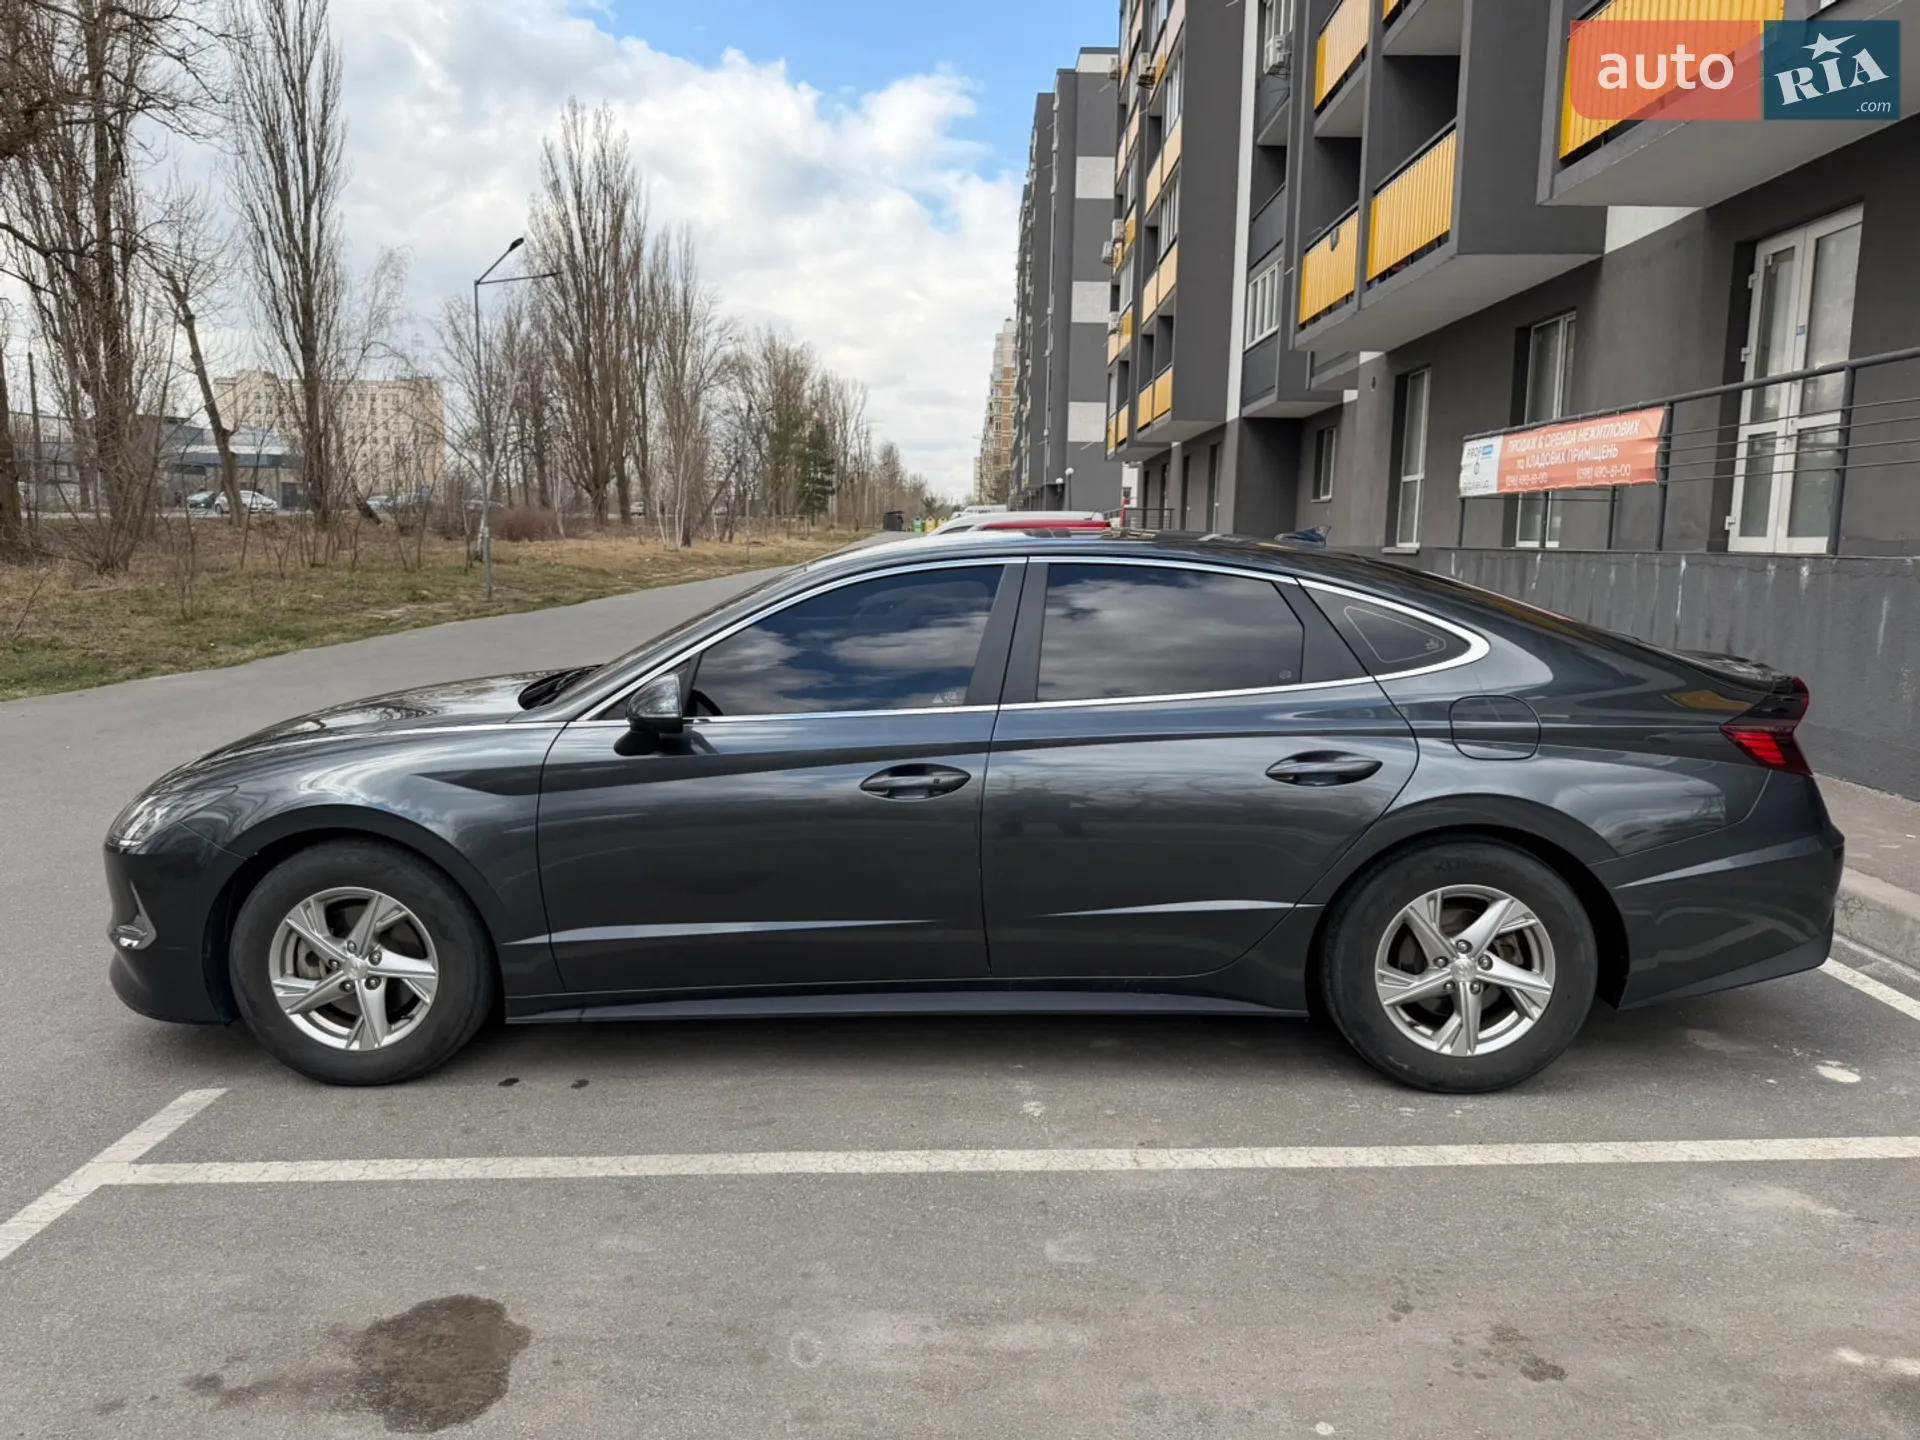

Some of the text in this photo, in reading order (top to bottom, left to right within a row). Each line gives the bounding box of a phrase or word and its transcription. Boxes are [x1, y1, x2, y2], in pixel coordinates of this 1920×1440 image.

[1507, 436, 1537, 453] ПРОДАЖ
[1545, 429, 1577, 448] ОРЕНДА
[1577, 419, 1641, 443] НЕЖИТЛОВИХ
[1525, 450, 1566, 469] КЛАДОВИХ
[1566, 443, 1619, 463] ПРИМІЩЕНЬ
